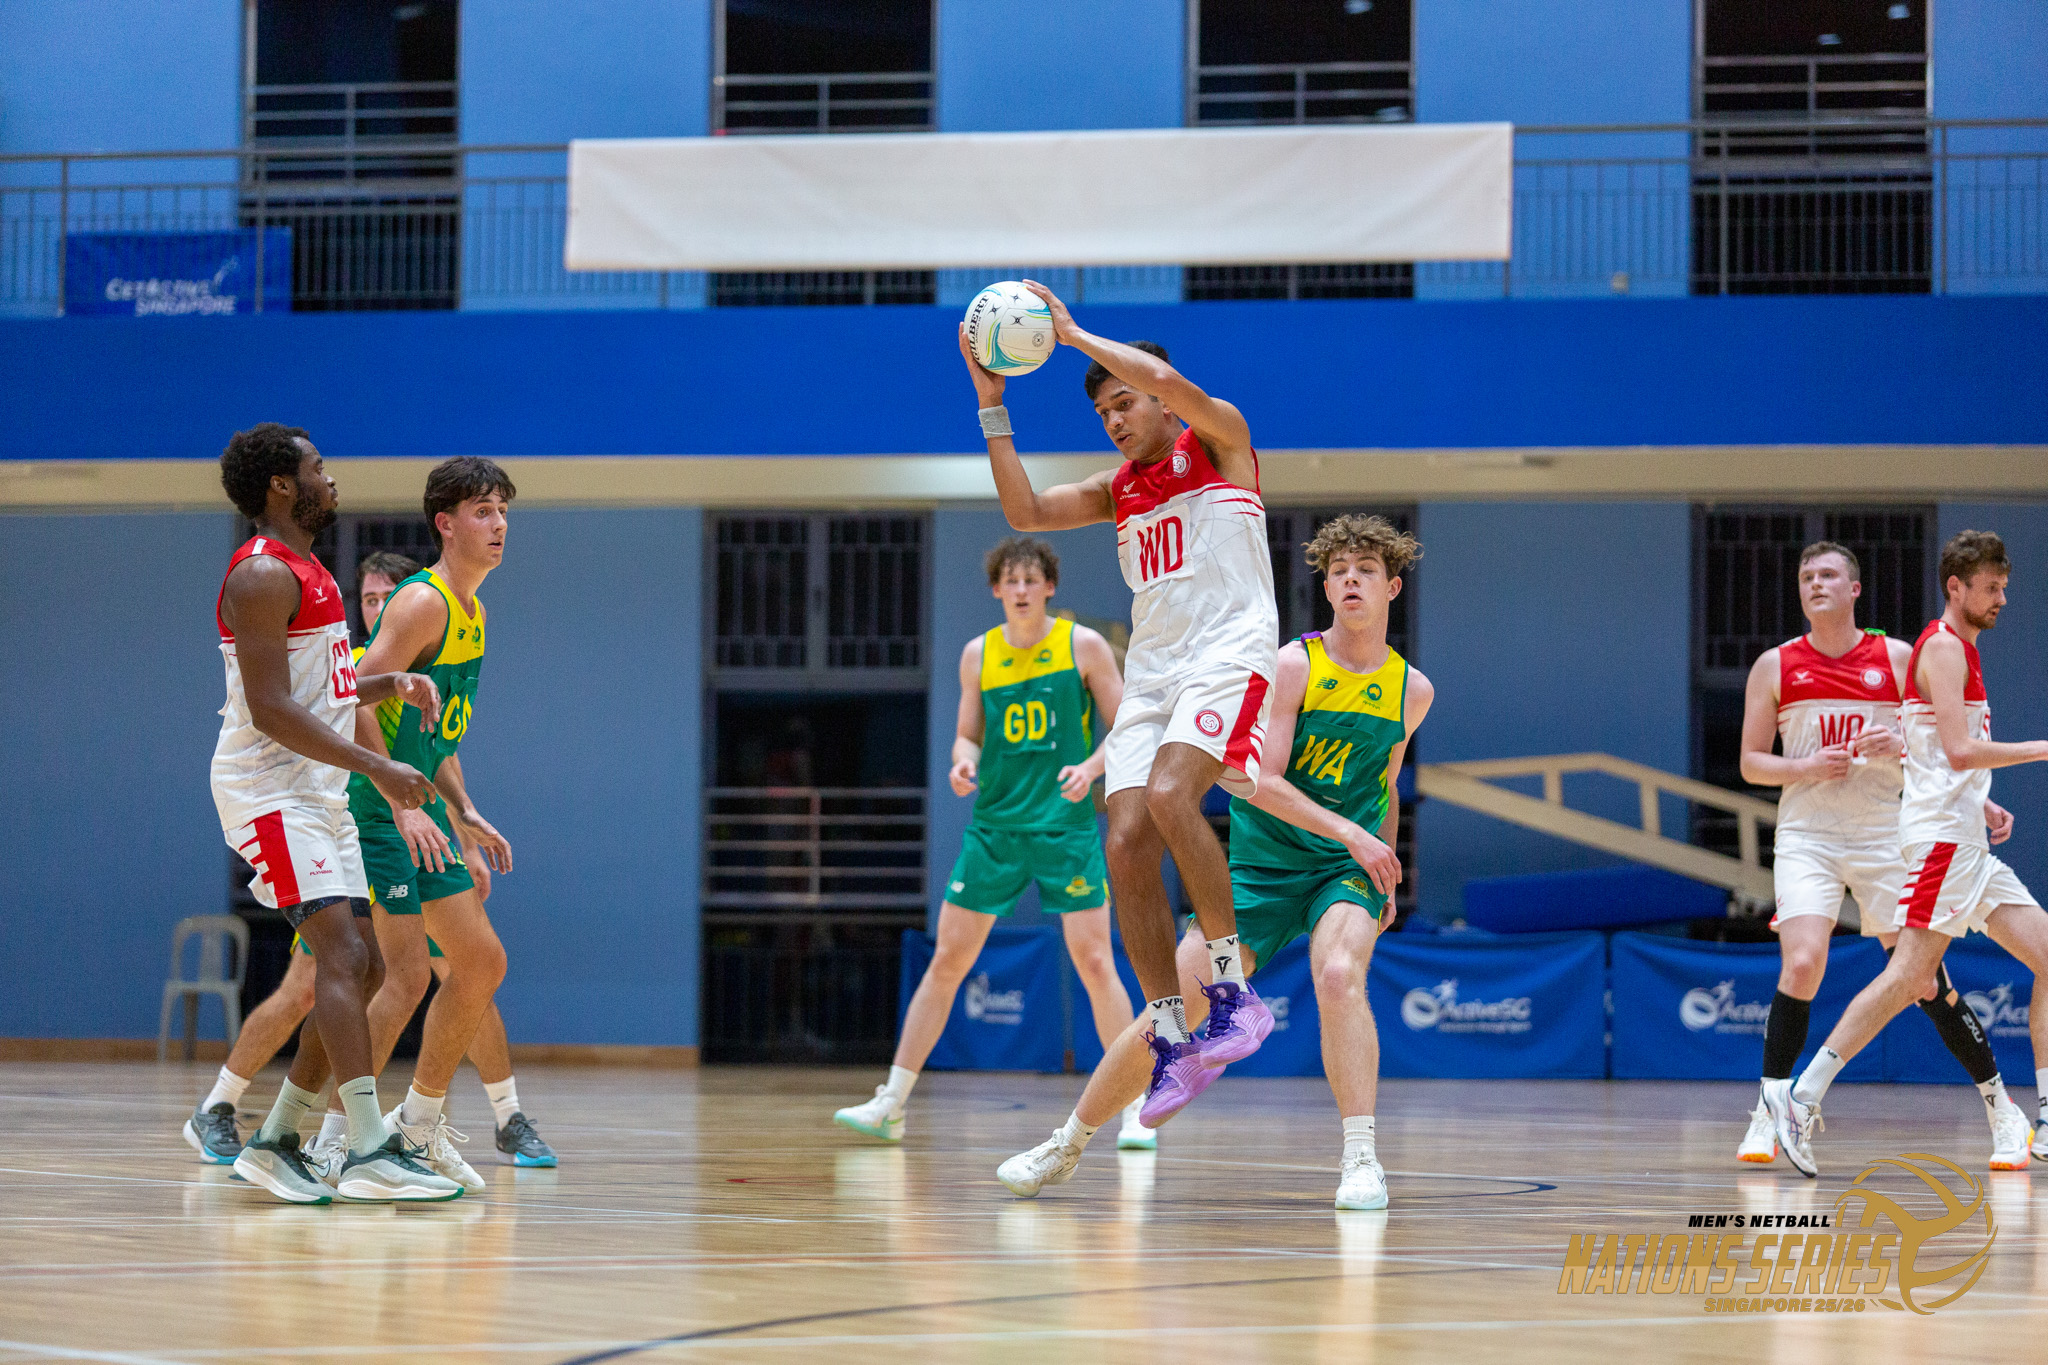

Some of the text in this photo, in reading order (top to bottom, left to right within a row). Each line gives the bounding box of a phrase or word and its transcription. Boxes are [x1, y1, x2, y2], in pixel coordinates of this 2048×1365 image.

[1137, 516, 1183, 582] WD
[1004, 701, 1047, 743] GD
[1295, 735, 1353, 786] WA
